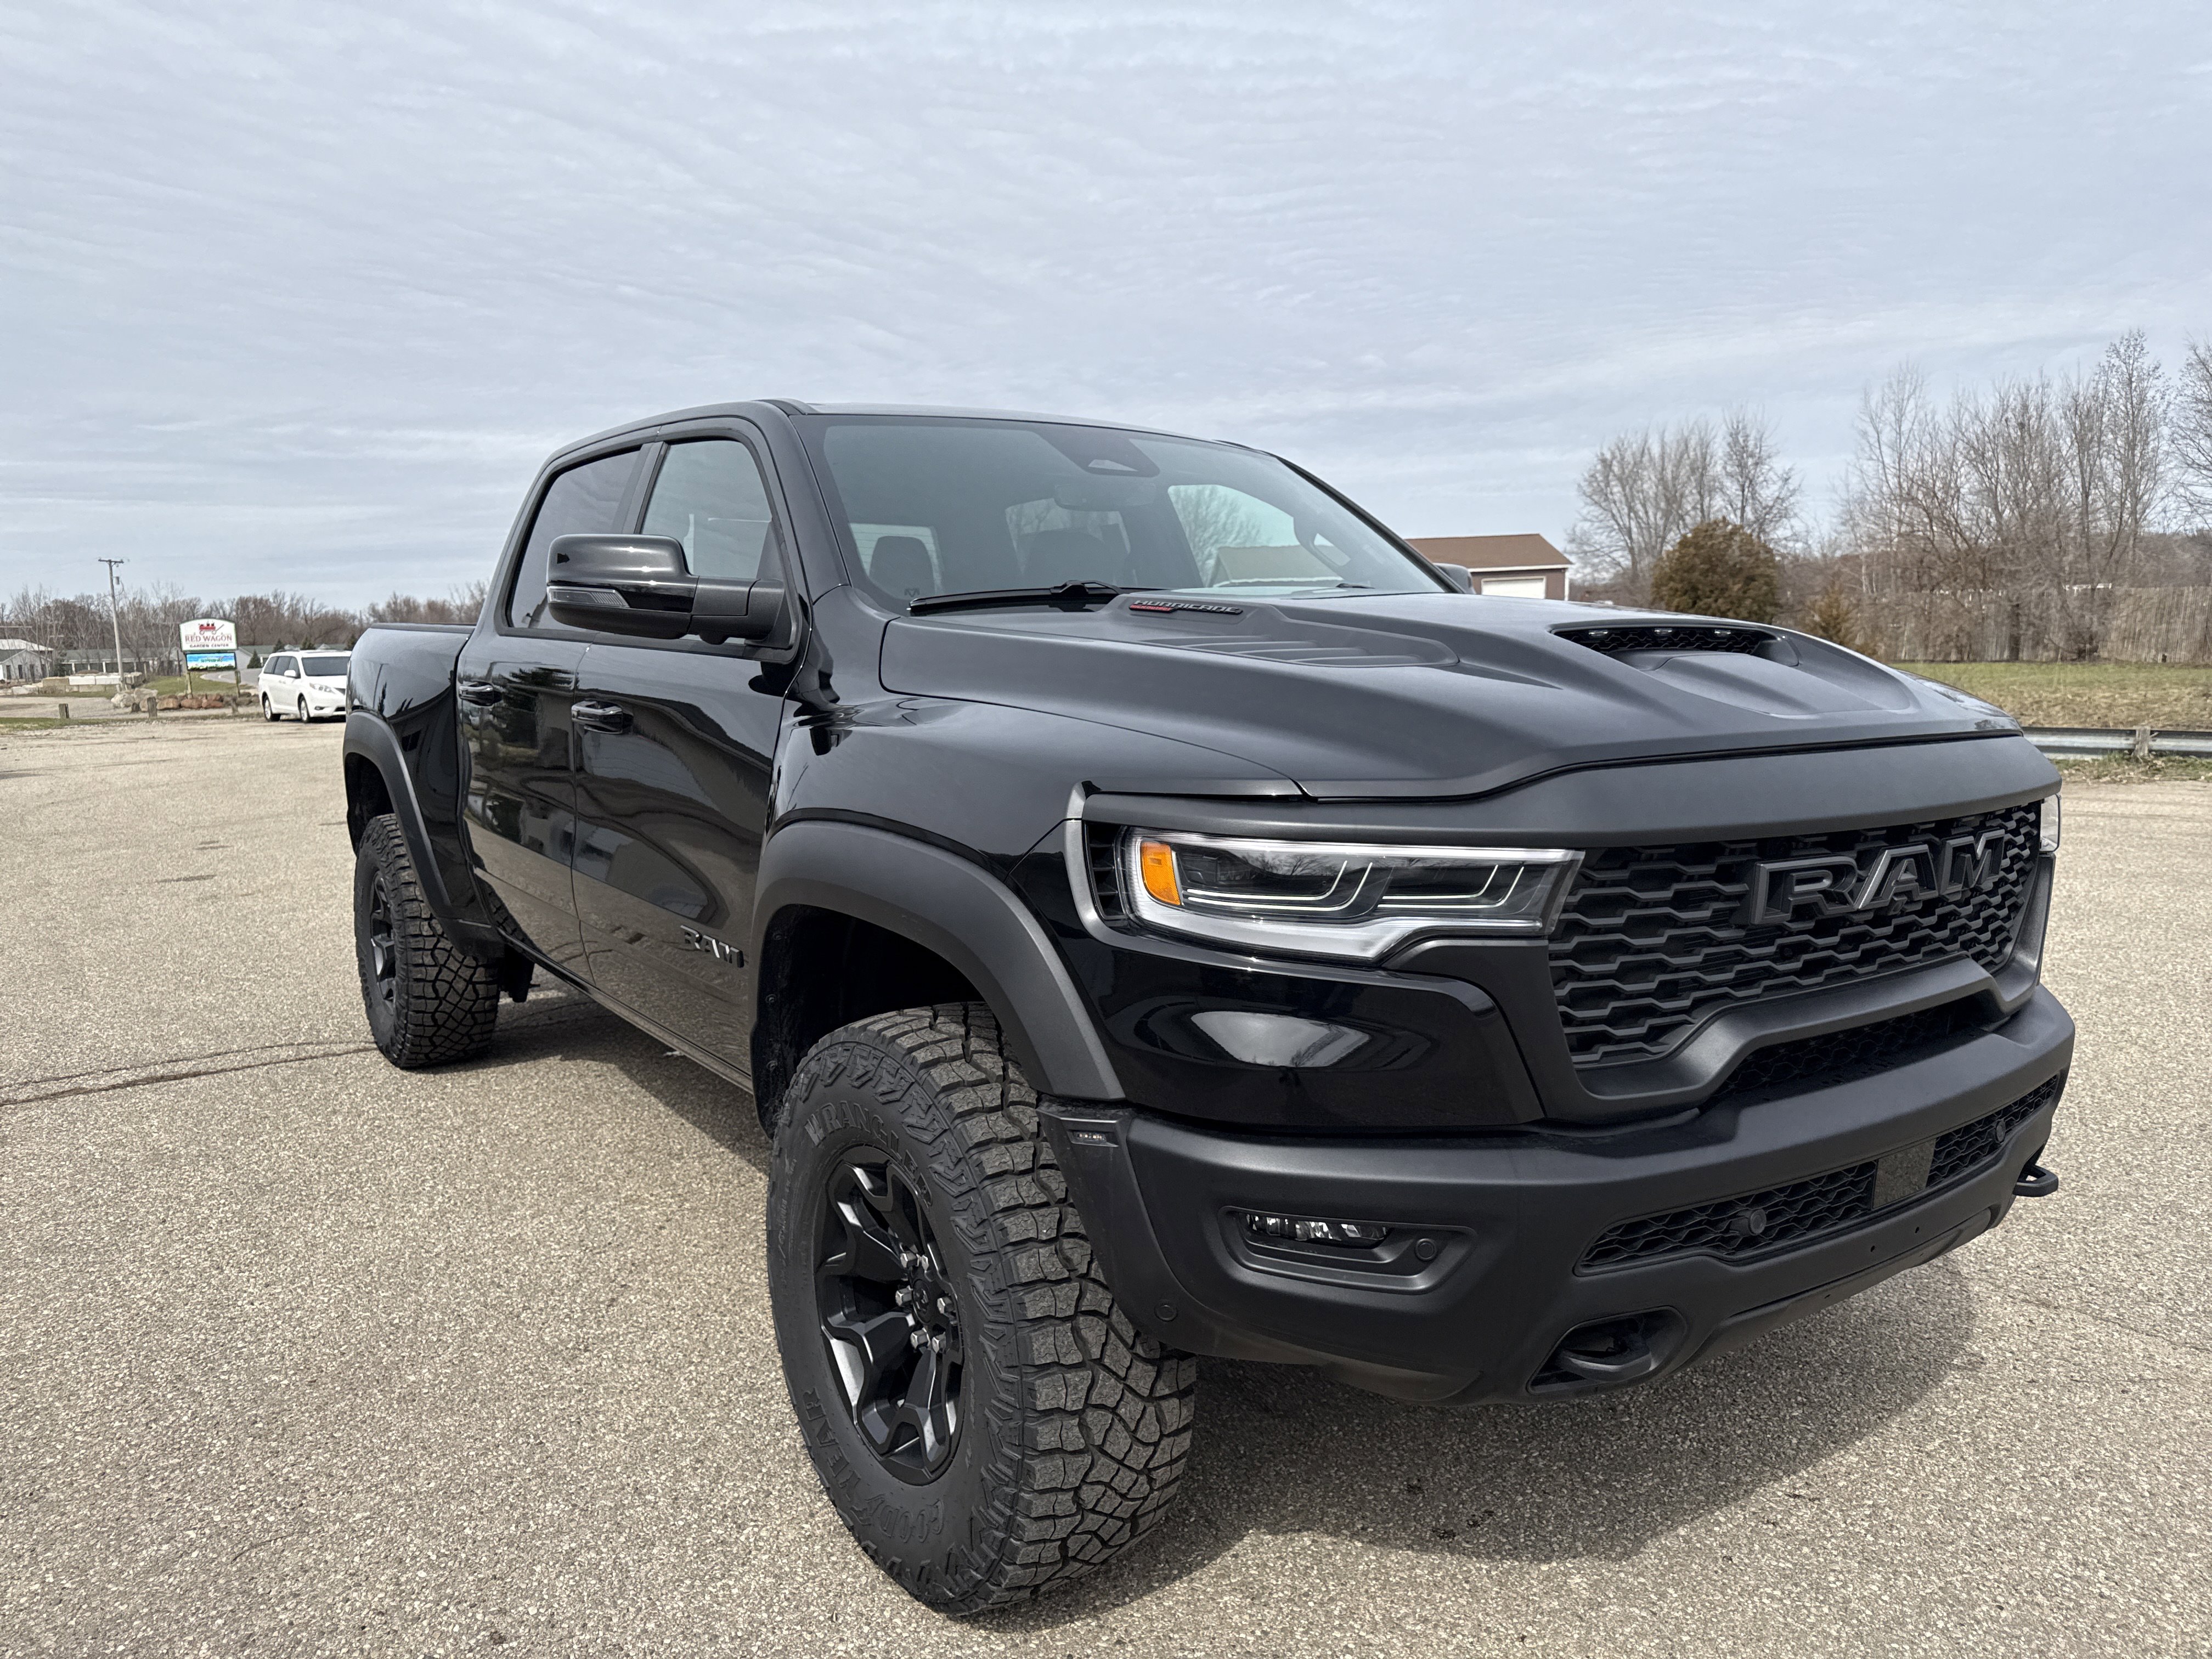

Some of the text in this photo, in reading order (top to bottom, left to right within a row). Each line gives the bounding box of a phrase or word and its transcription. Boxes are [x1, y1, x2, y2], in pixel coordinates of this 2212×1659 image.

[1134, 600, 1239, 612] HURRICANE
[1750, 827, 2006, 926] RAM
[680, 924, 744, 968] RAM
[804, 1100, 933, 1209] WRANGLER
[803, 1386, 944, 1543] GOODYEAR
